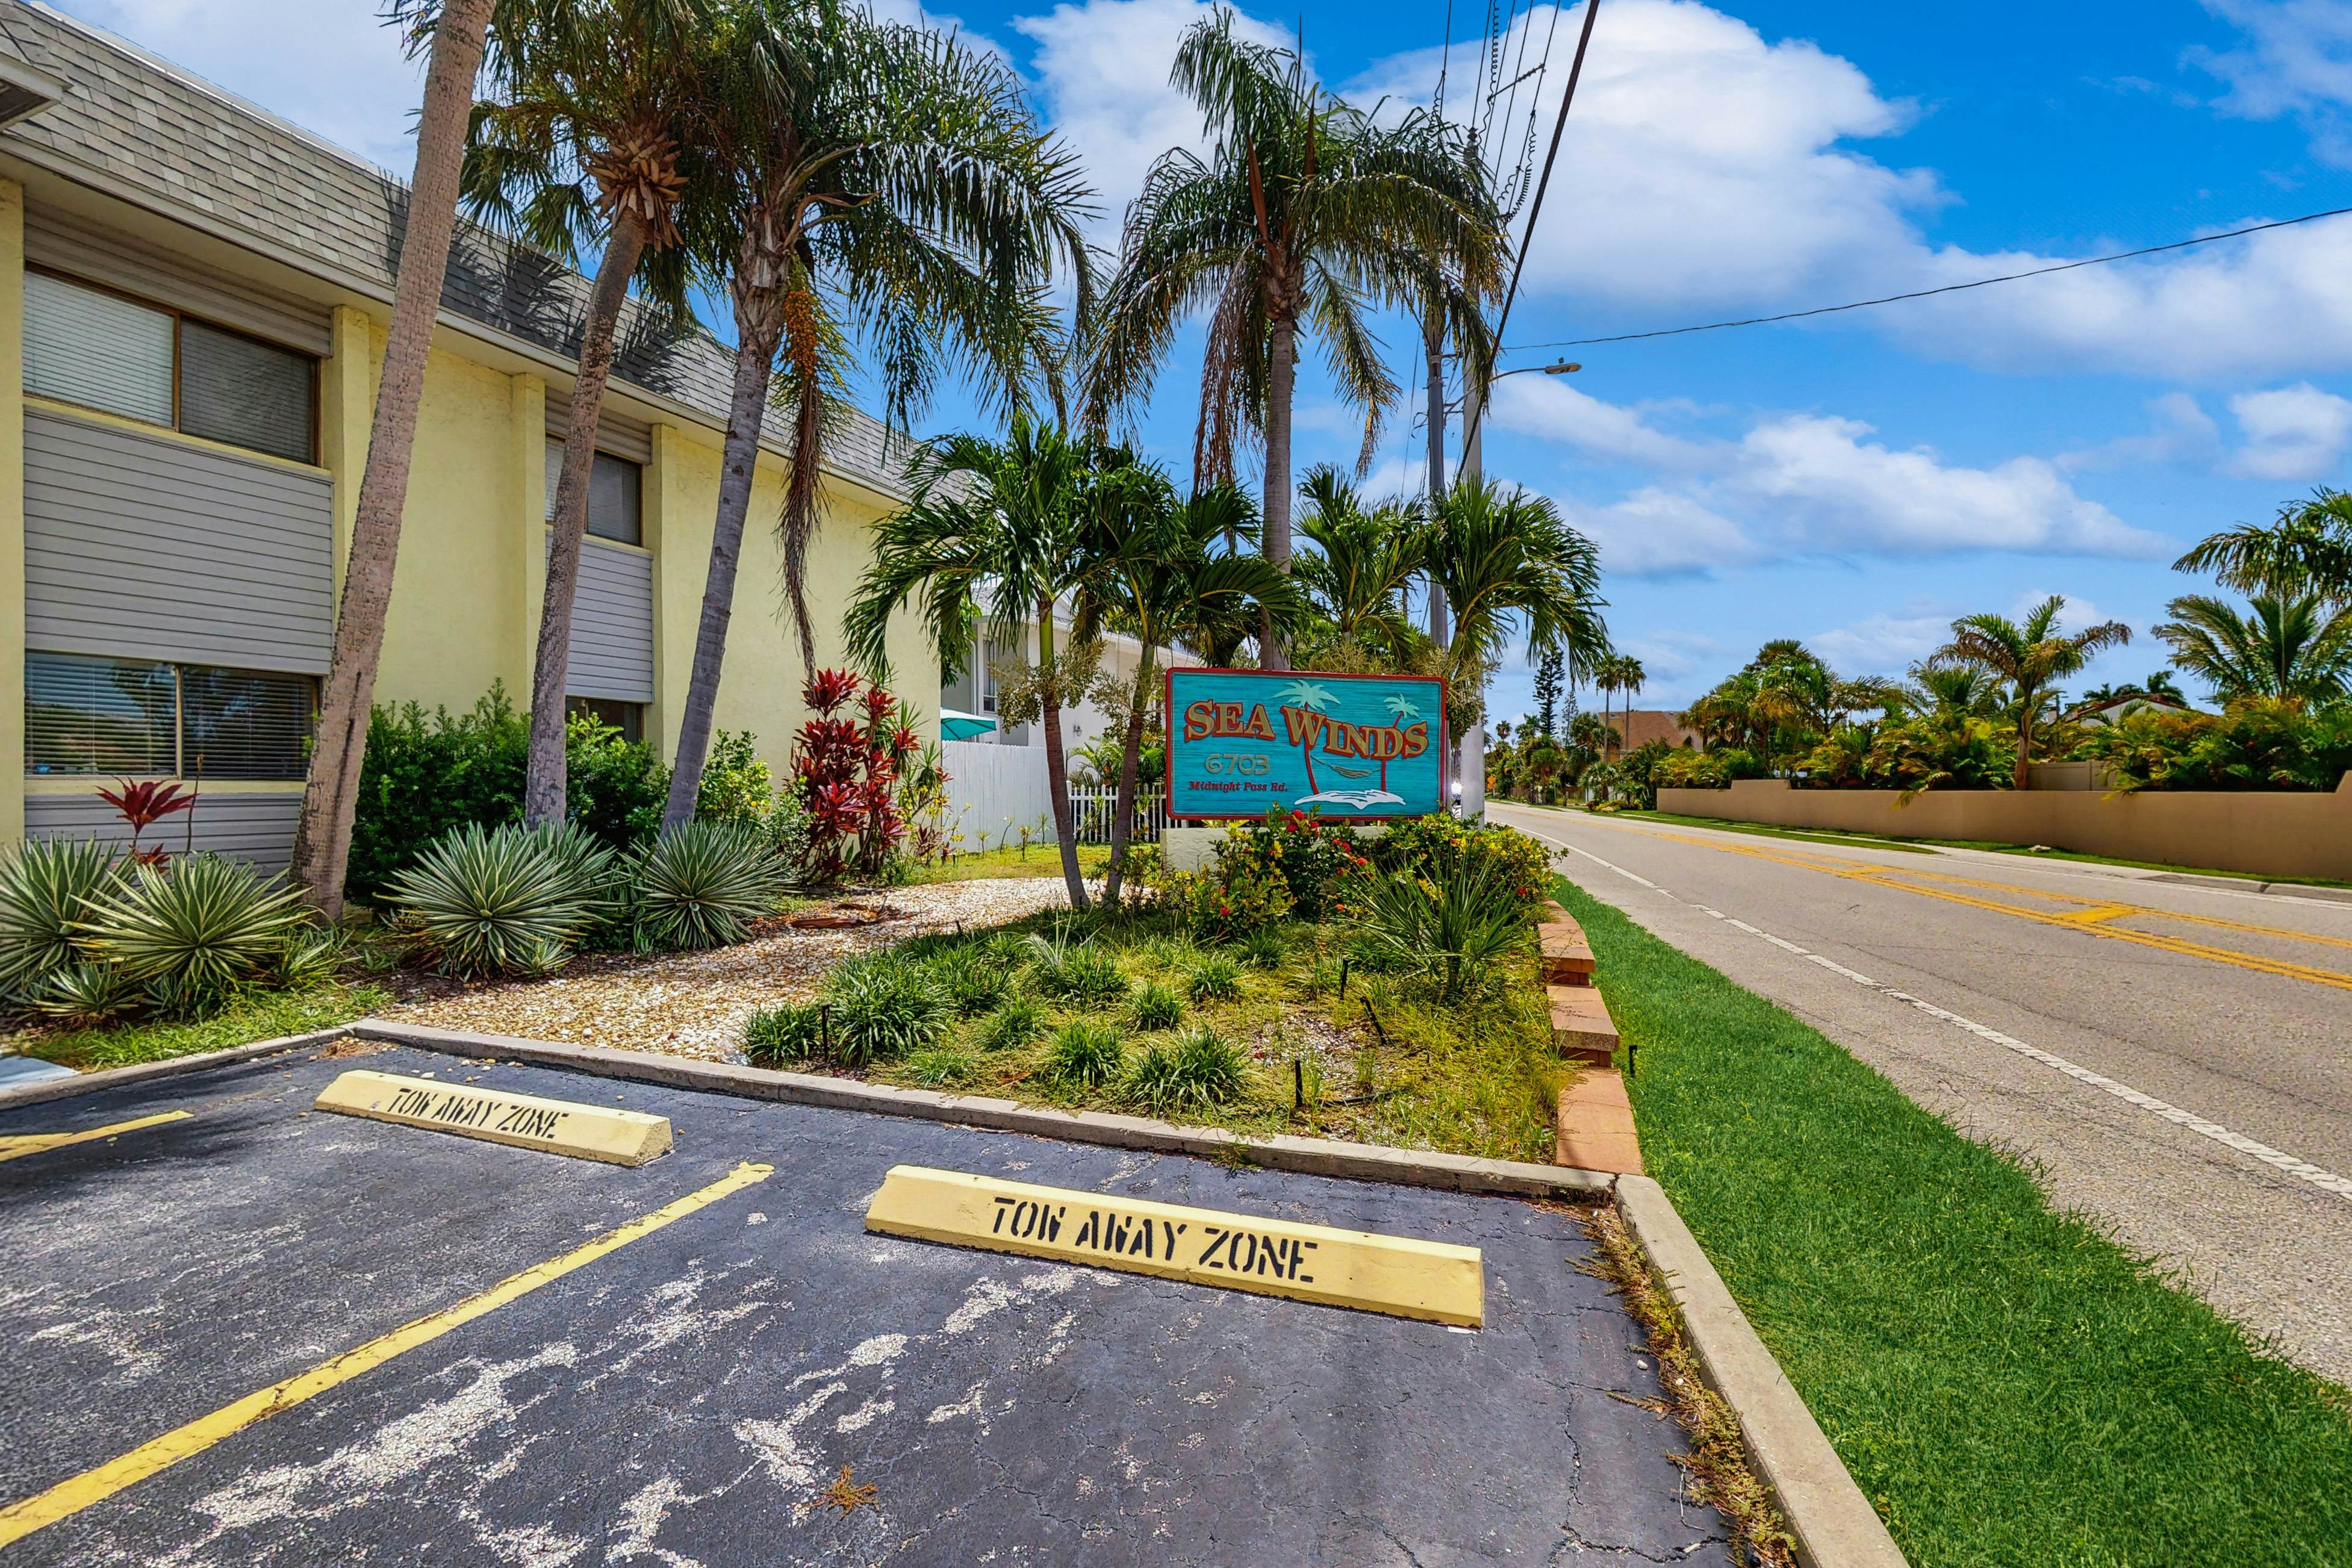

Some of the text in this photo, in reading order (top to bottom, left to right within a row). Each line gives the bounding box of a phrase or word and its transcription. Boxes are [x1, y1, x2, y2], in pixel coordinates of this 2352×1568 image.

[1184, 699, 1429, 761] SEA WINDS
[1188, 780, 1289, 793] Midnight Pass Rd.
[1205, 753, 1271, 776] 6703
[387, 1087, 570, 1139] TOW AWAY ZONE
[992, 1196, 1319, 1283] TOW AWAY ZONE
